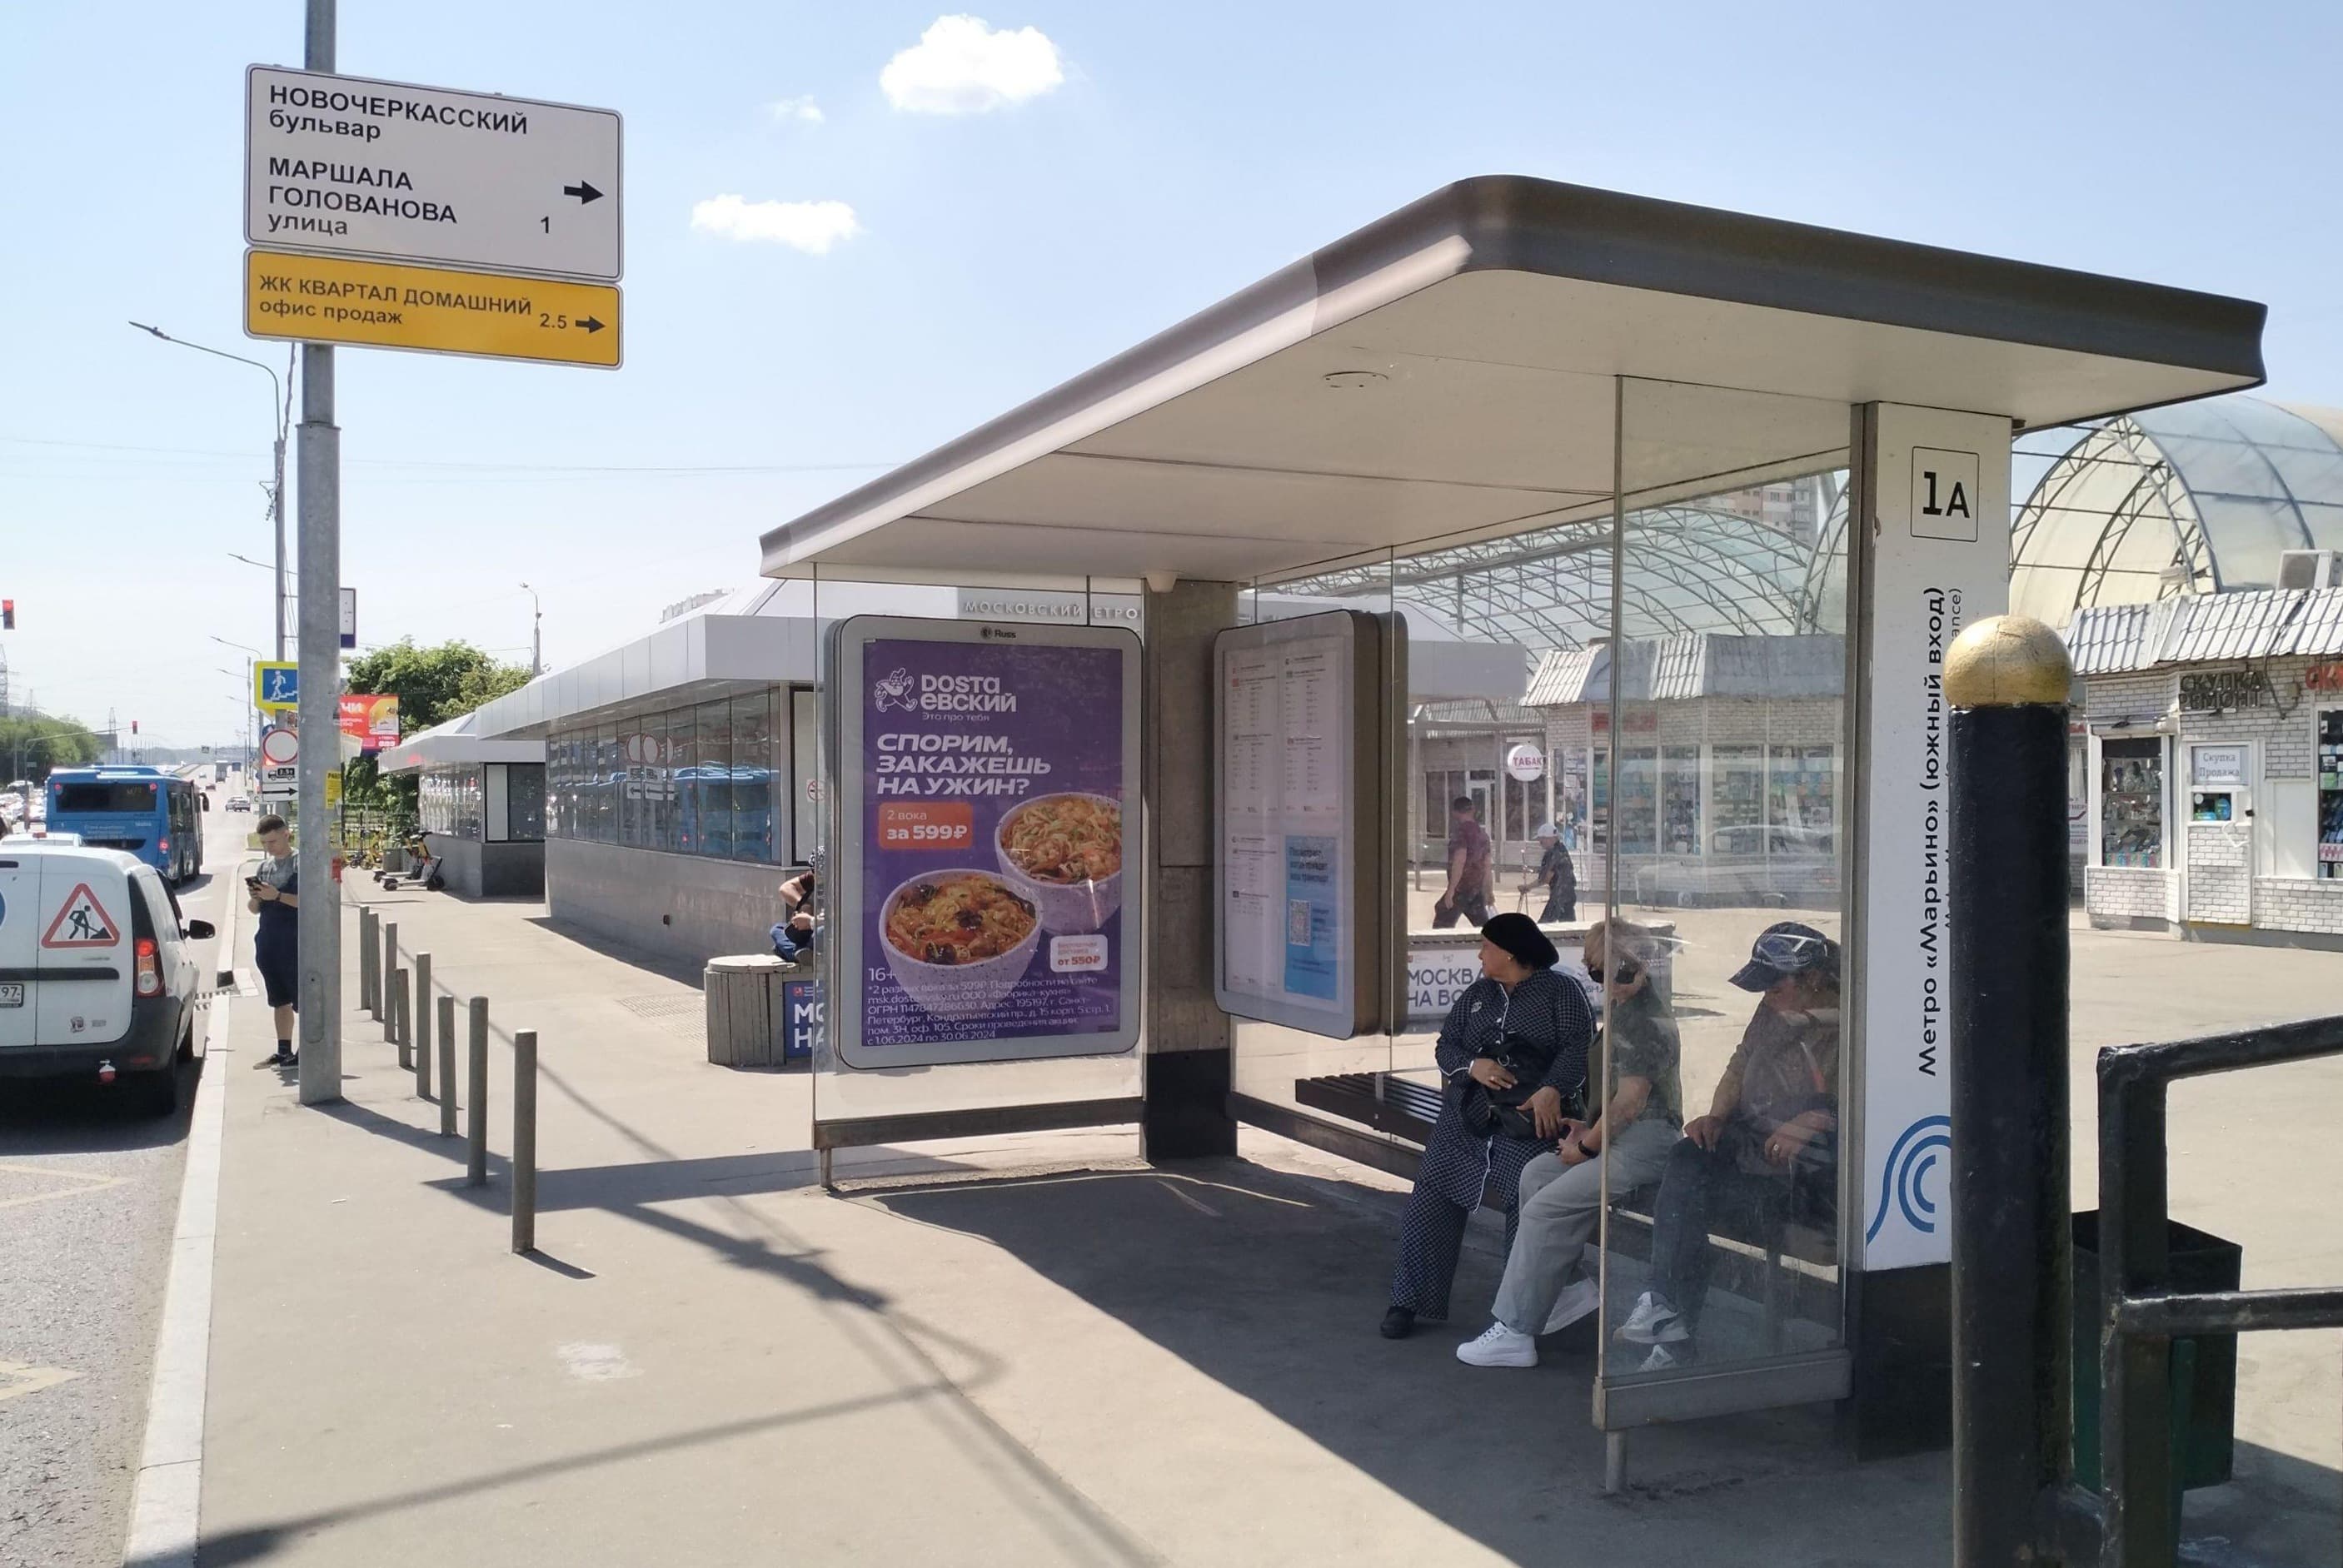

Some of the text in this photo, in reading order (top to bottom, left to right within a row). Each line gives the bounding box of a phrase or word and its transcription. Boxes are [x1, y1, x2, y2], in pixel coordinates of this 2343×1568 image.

[270, 84, 527, 134] НОВОЧЕРКАССКИЙ
[269, 109, 381, 142] бульвар
[268, 157, 413, 191] МАРШАЛА
[268, 186, 457, 224] ГОЛОВАНОВА
[267, 213, 348, 236] улица
[541, 216, 551, 234] 1
[259, 274, 531, 316] ЖК КВАРТАЛ ДОМАШНИЙ
[259, 299, 402, 325] офис продаж
[539, 312, 567, 329] 2.5
[965, 600, 1083, 617] МОСКОВСКИЙ
[1948, 588, 1962, 641] ance)
[877, 733, 1014, 755] СПОРИМ,
[875, 754, 1052, 774] ЗАКАЖЕШЬ
[1513, 756, 1543, 766] ТАБАК
[2203, 752, 2236, 764] Скупка
[2199, 766, 2240, 779] Продажа
[877, 776, 1030, 795] НА УЖИН?
[887, 809, 927, 821] 2 вока
[886, 828, 910, 840] за
[1918, 587, 1945, 1077] Метро «Марьино» (южный вход)
[868, 968, 896, 982] 16+
[868, 1005, 899, 1014] ОГРН
